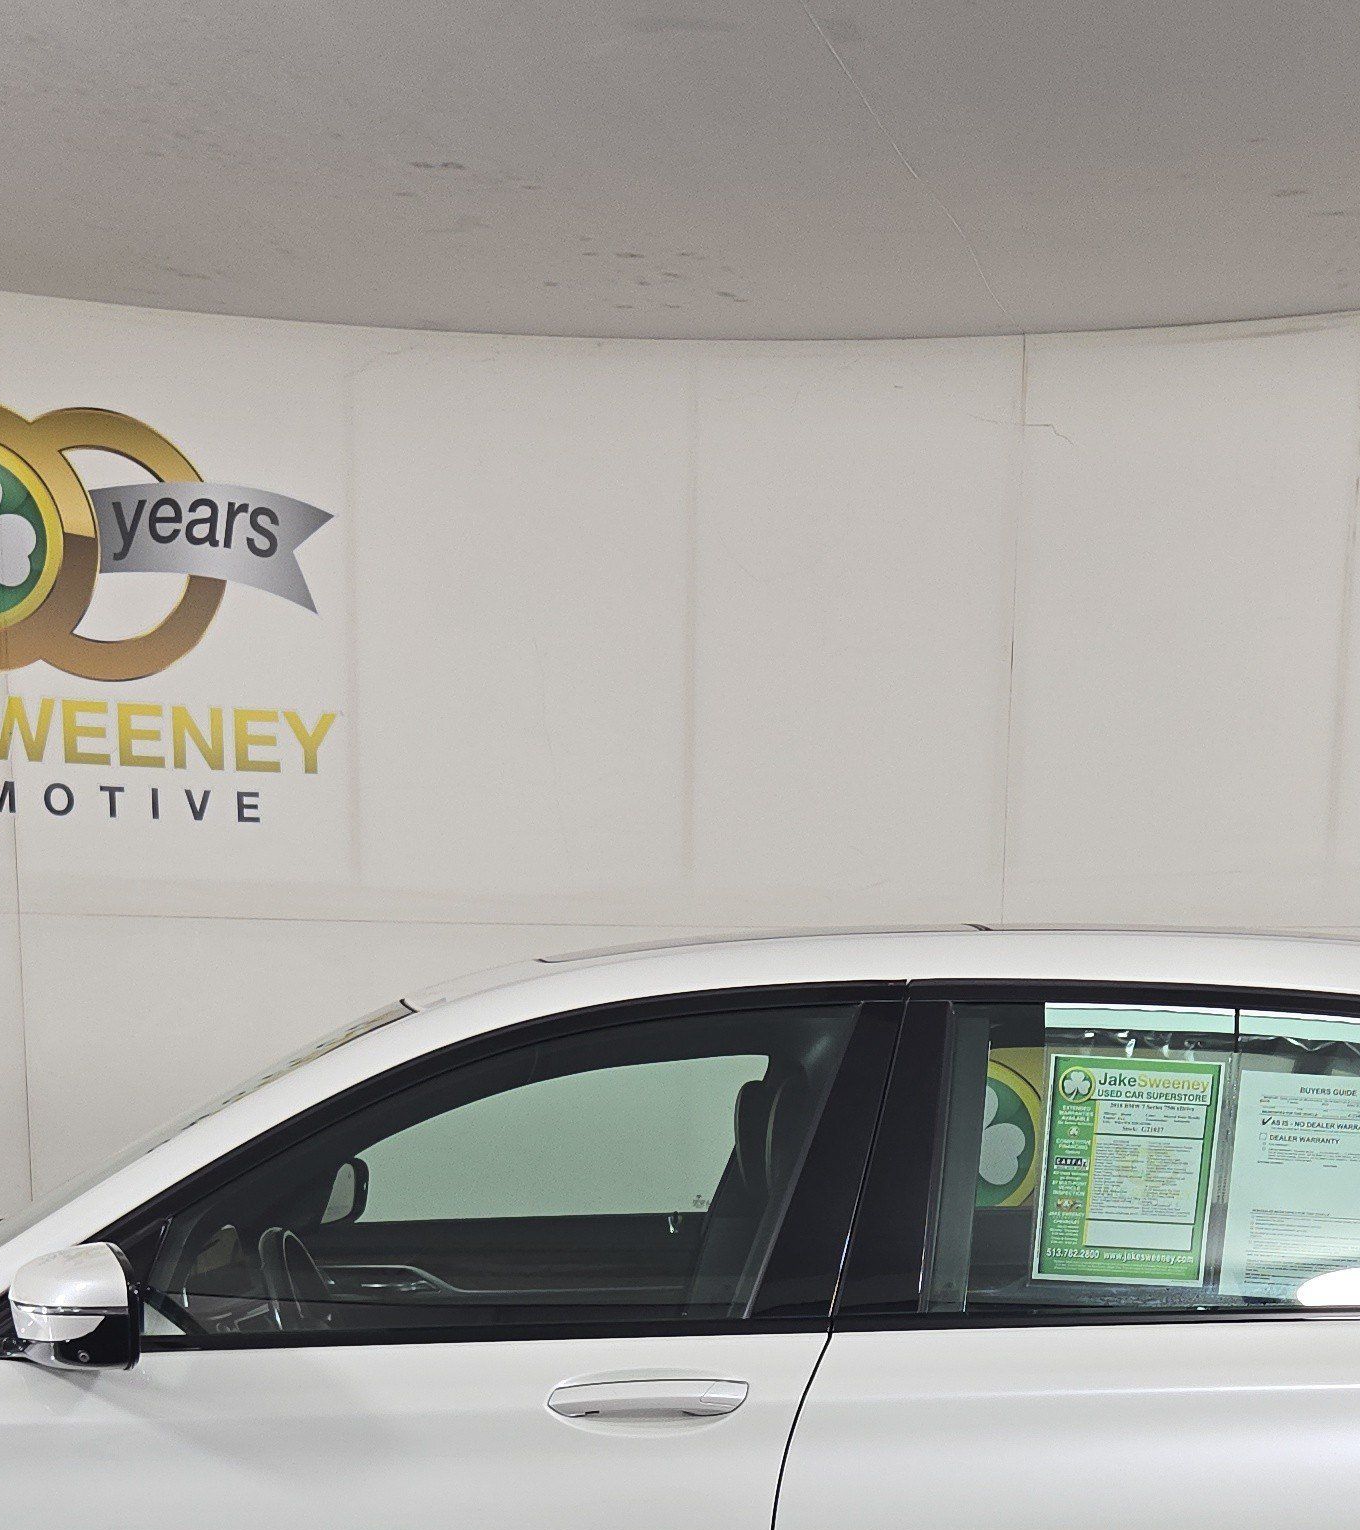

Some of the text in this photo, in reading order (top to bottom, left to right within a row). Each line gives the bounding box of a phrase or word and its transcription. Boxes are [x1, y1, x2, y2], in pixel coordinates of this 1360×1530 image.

[111, 494, 281, 561] years
[1097, 1089, 1208, 1102] USED CAR SUPERSTORE
[1299, 1087, 1358, 1097] BUYERS GUIDE
[1269, 1134, 1298, 1142] DEALER
[1299, 1136, 1340, 1145] WARRANTY
[1103, 1252, 1194, 1264] www.jakesweeney.com
